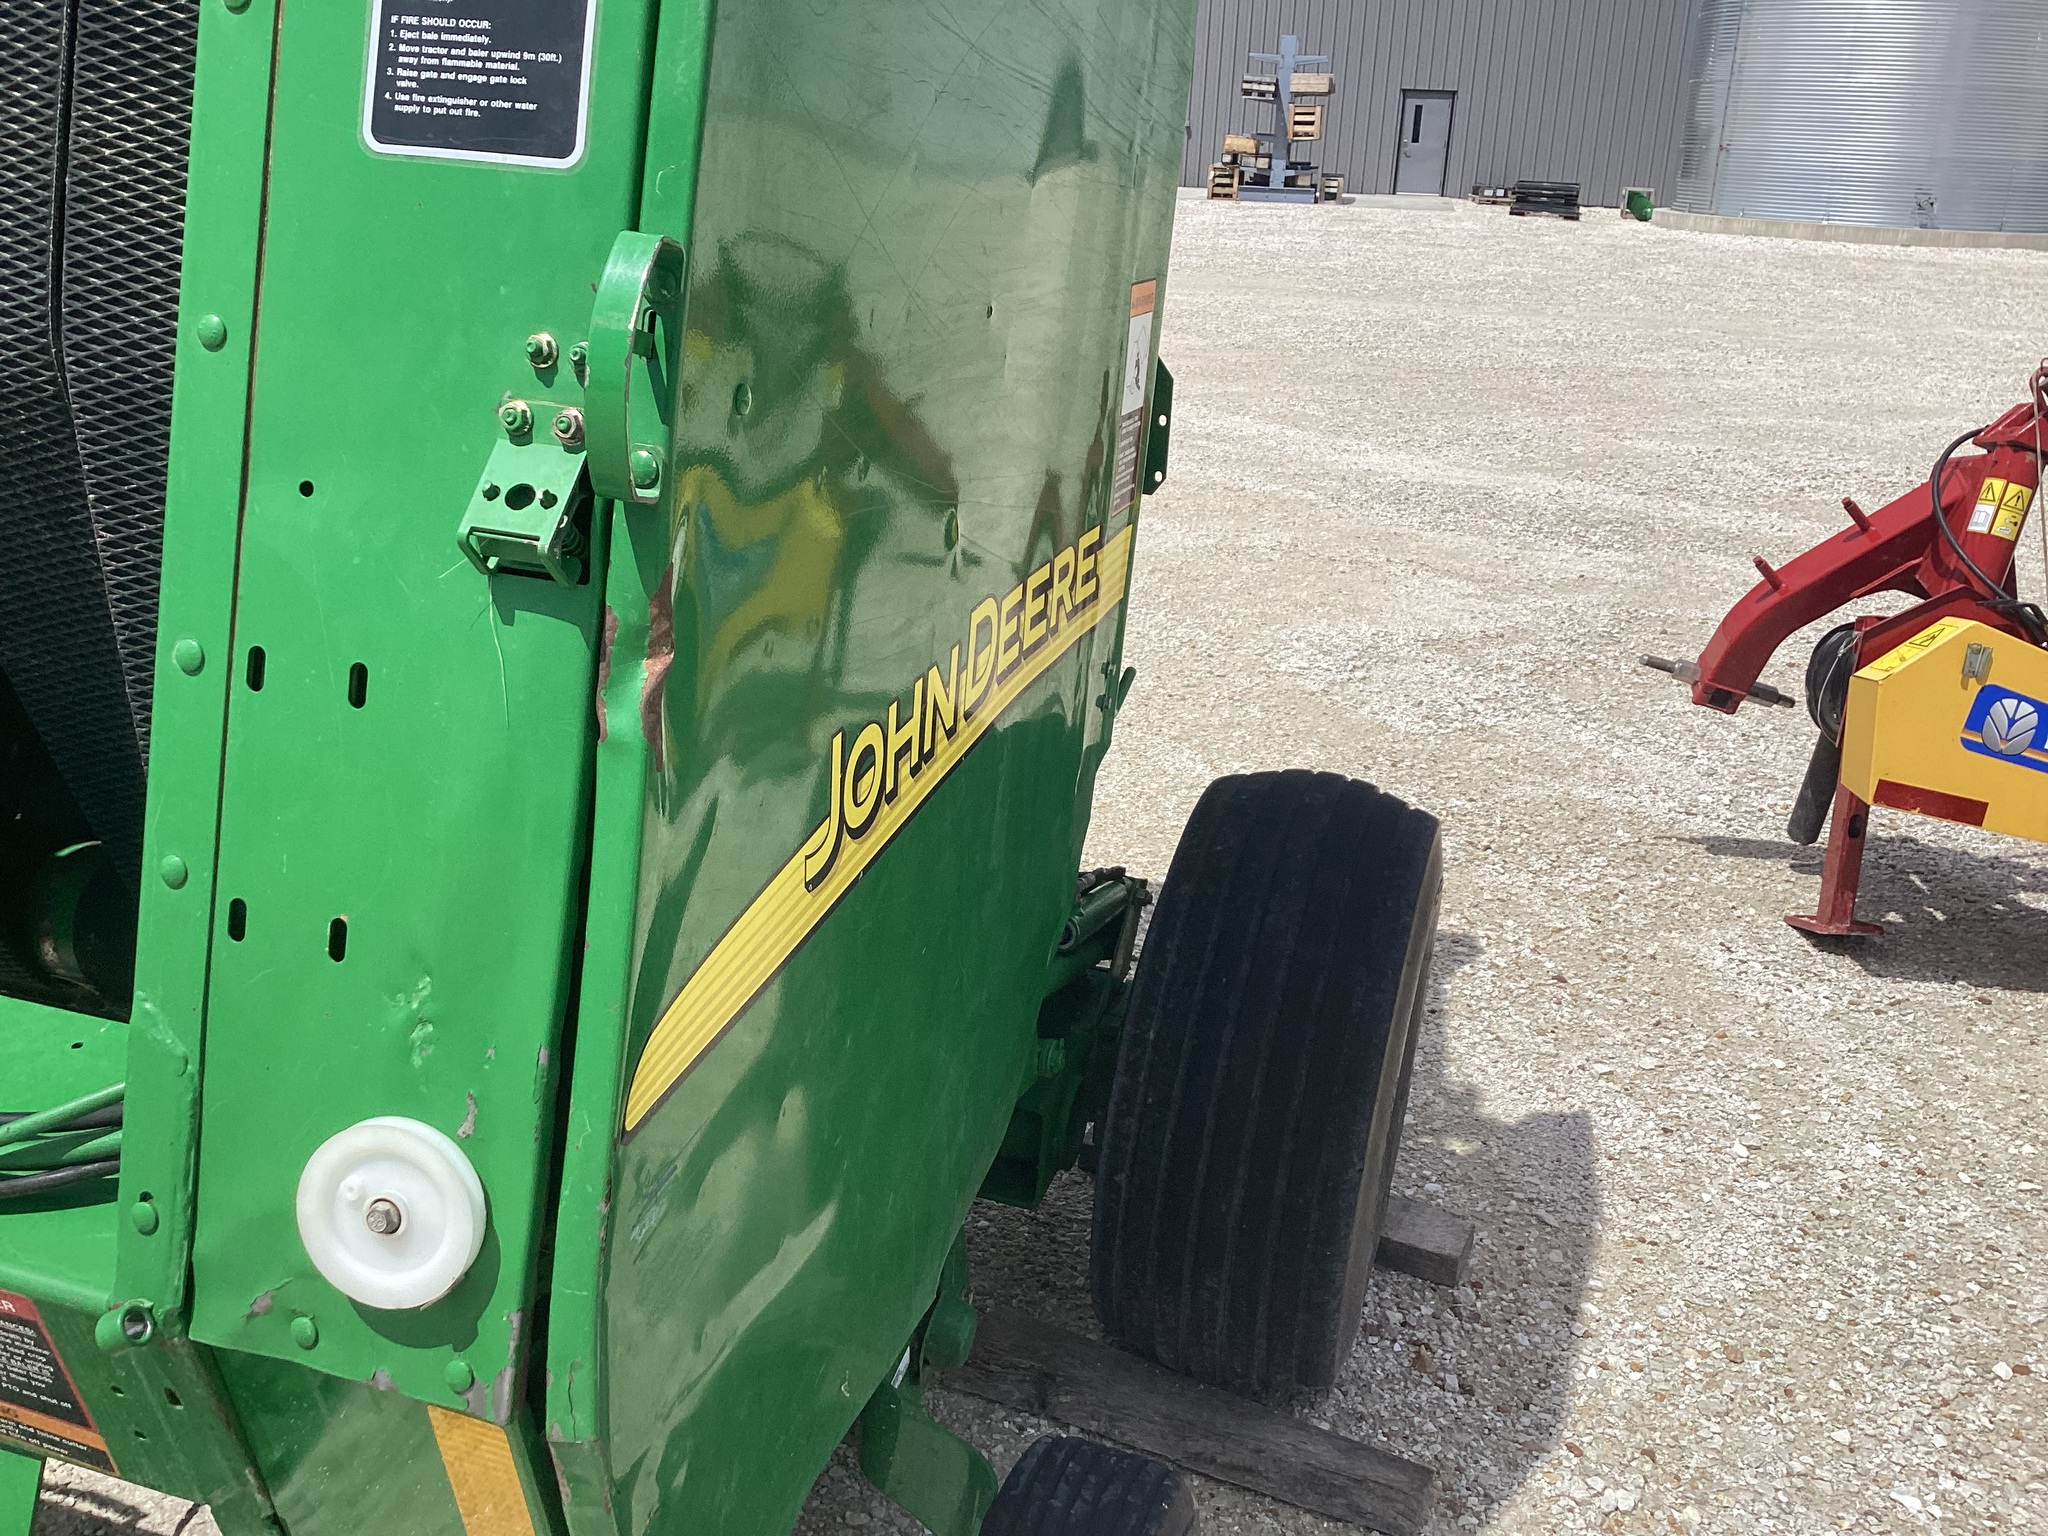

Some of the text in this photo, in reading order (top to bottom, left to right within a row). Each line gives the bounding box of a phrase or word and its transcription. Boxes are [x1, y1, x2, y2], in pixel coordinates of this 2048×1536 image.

[390, 15, 492, 30] IF FIRE SHOULD OCCUR:
[390, 29, 492, 46] 1. Eject bale immediately.
[388, 42, 562, 64] 2. Move tractor and baler upwind 9m (30ft.)
[397, 55, 521, 71] away from flammable material.
[386, 66, 528, 85] 3. Raise gate and engage gate lock
[396, 79, 420, 89] valve.
[384, 91, 538, 111] 4. Use fire extinguisher or other water
[394, 104, 481, 118] supply to put out fire.
[804, 524, 1102, 891] JOHN DEERE
[22, 1389, 38, 1398] and
